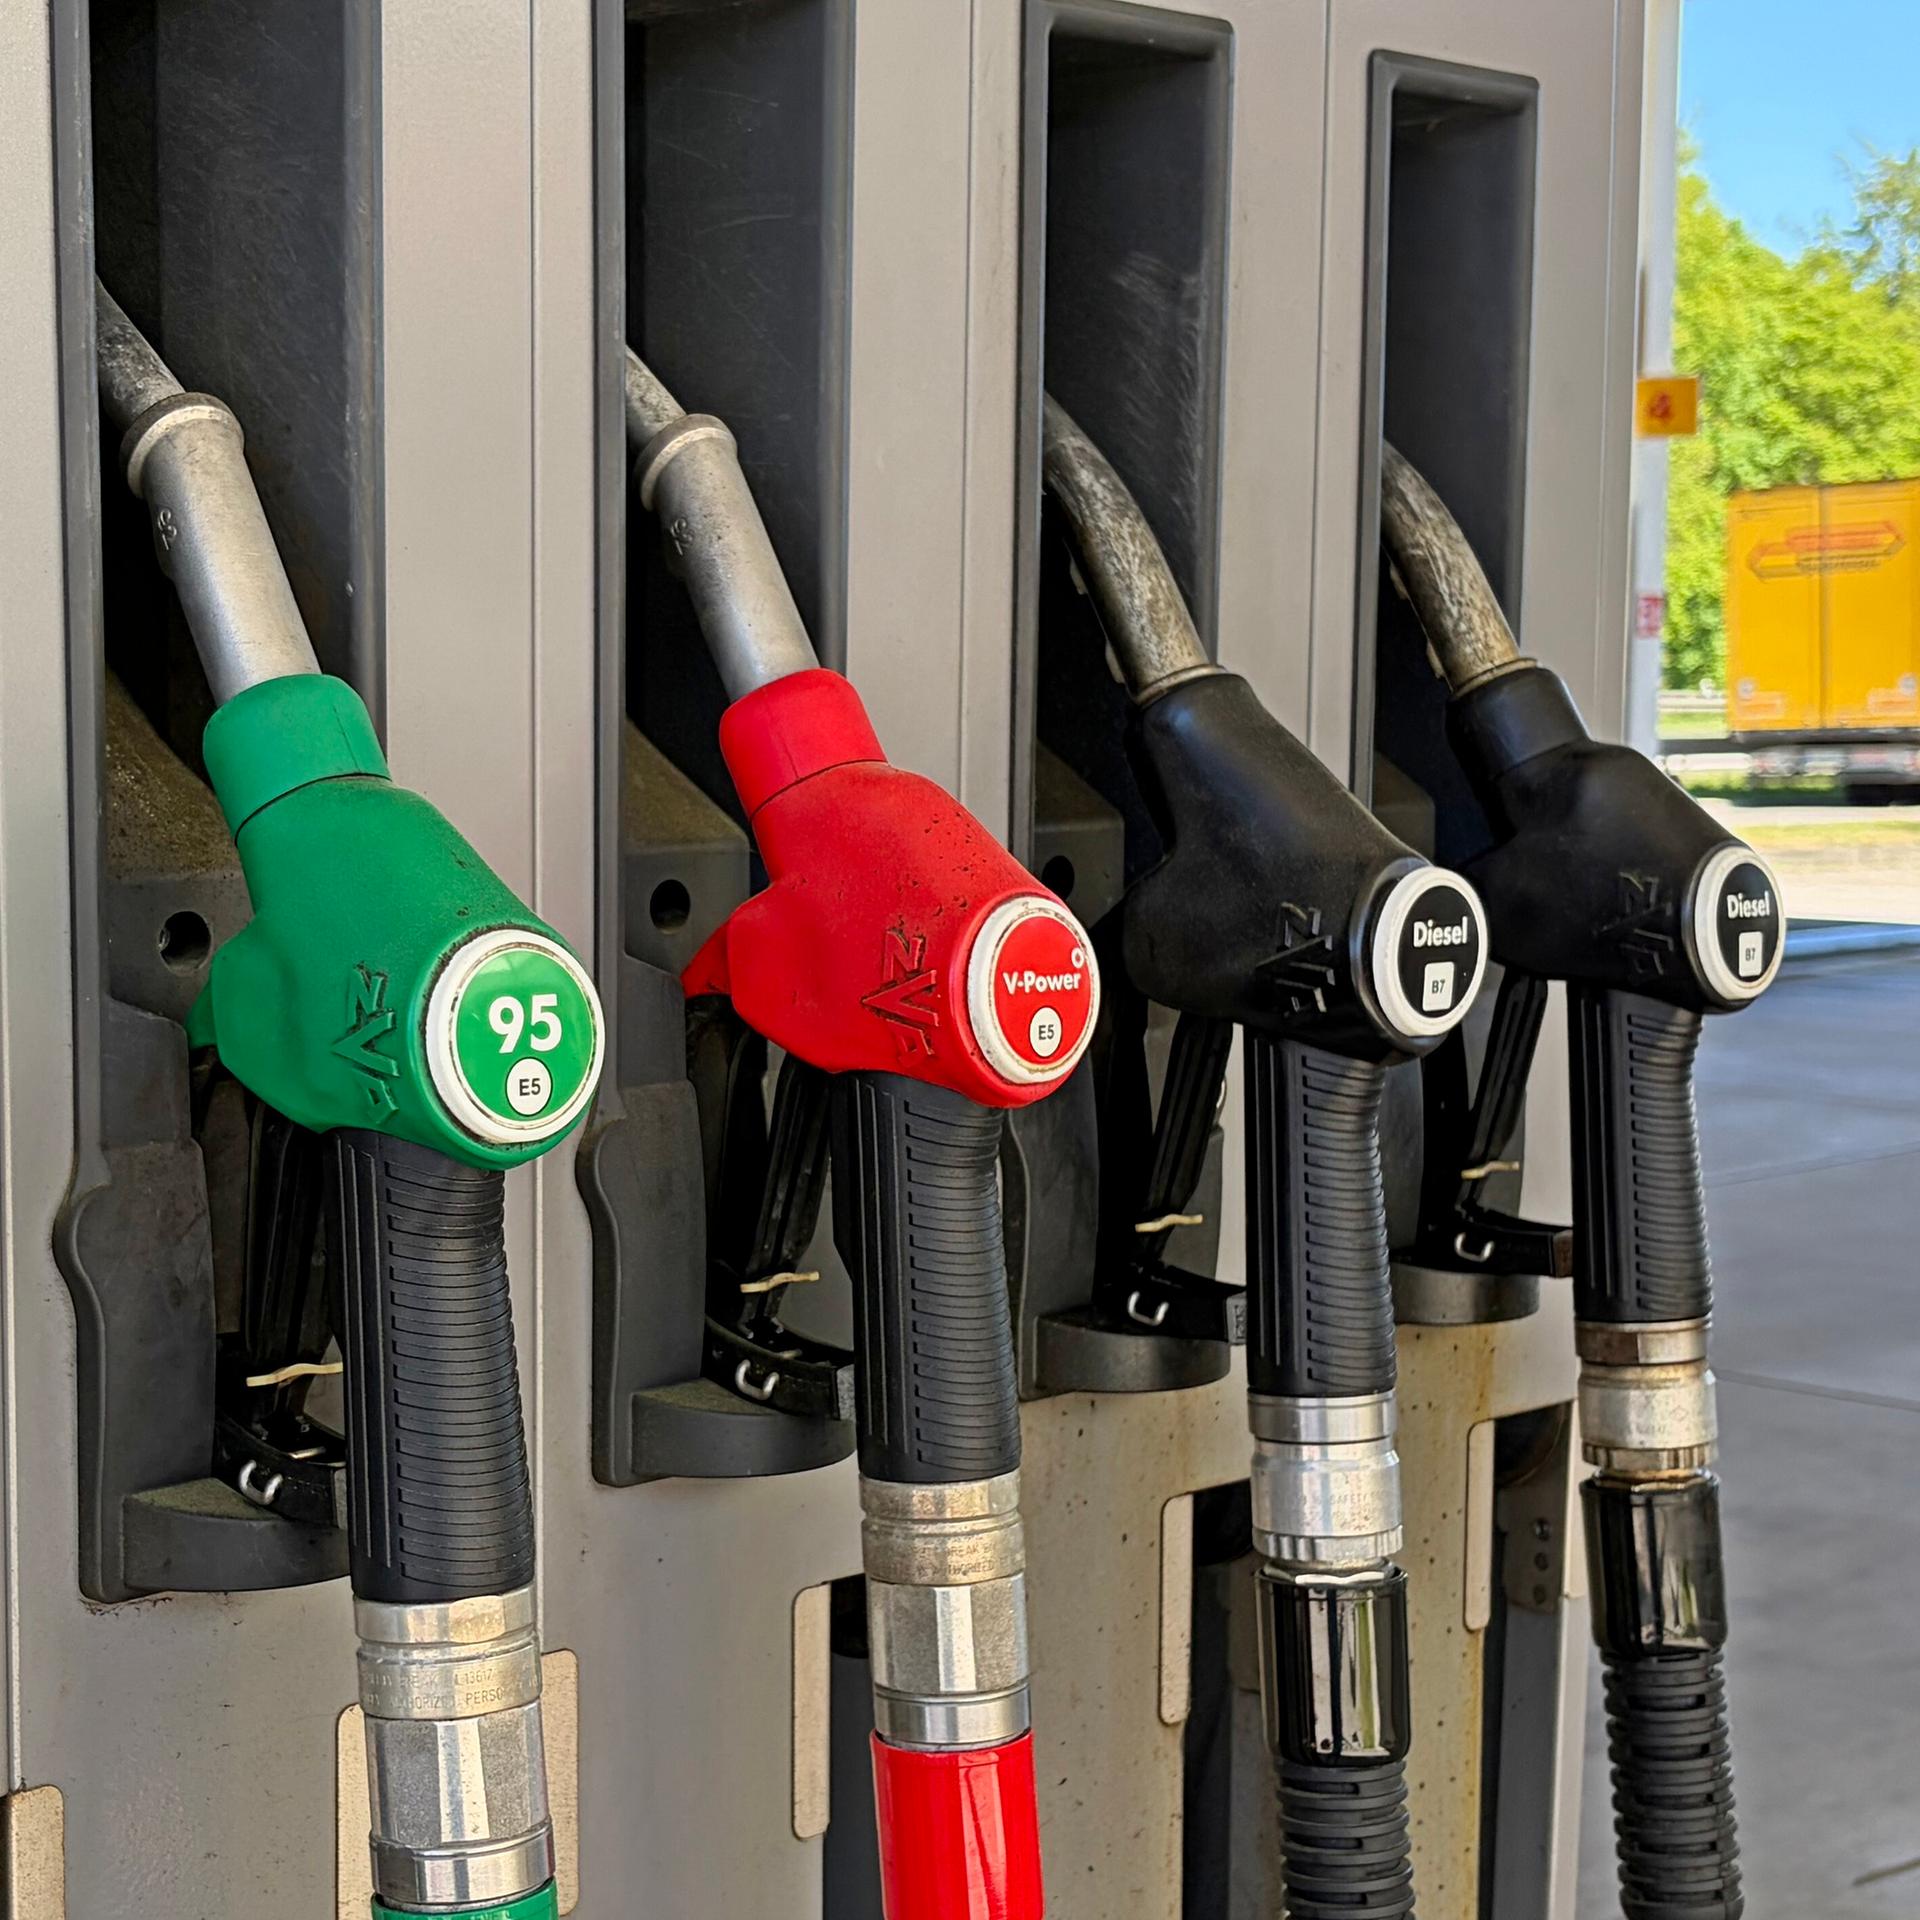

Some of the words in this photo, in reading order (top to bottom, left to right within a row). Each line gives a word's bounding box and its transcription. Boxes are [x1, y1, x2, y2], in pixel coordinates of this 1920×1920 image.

[1726, 890, 1771, 919] Diesel
[1412, 915, 1469, 948] Diesel
[1744, 947, 1757, 961] B7
[1002, 970, 1082, 995] V-Power
[1431, 979, 1446, 994] B7
[487, 993, 563, 1054] 95
[1037, 1024, 1055, 1040] E5
[518, 1078, 542, 1097] E5
